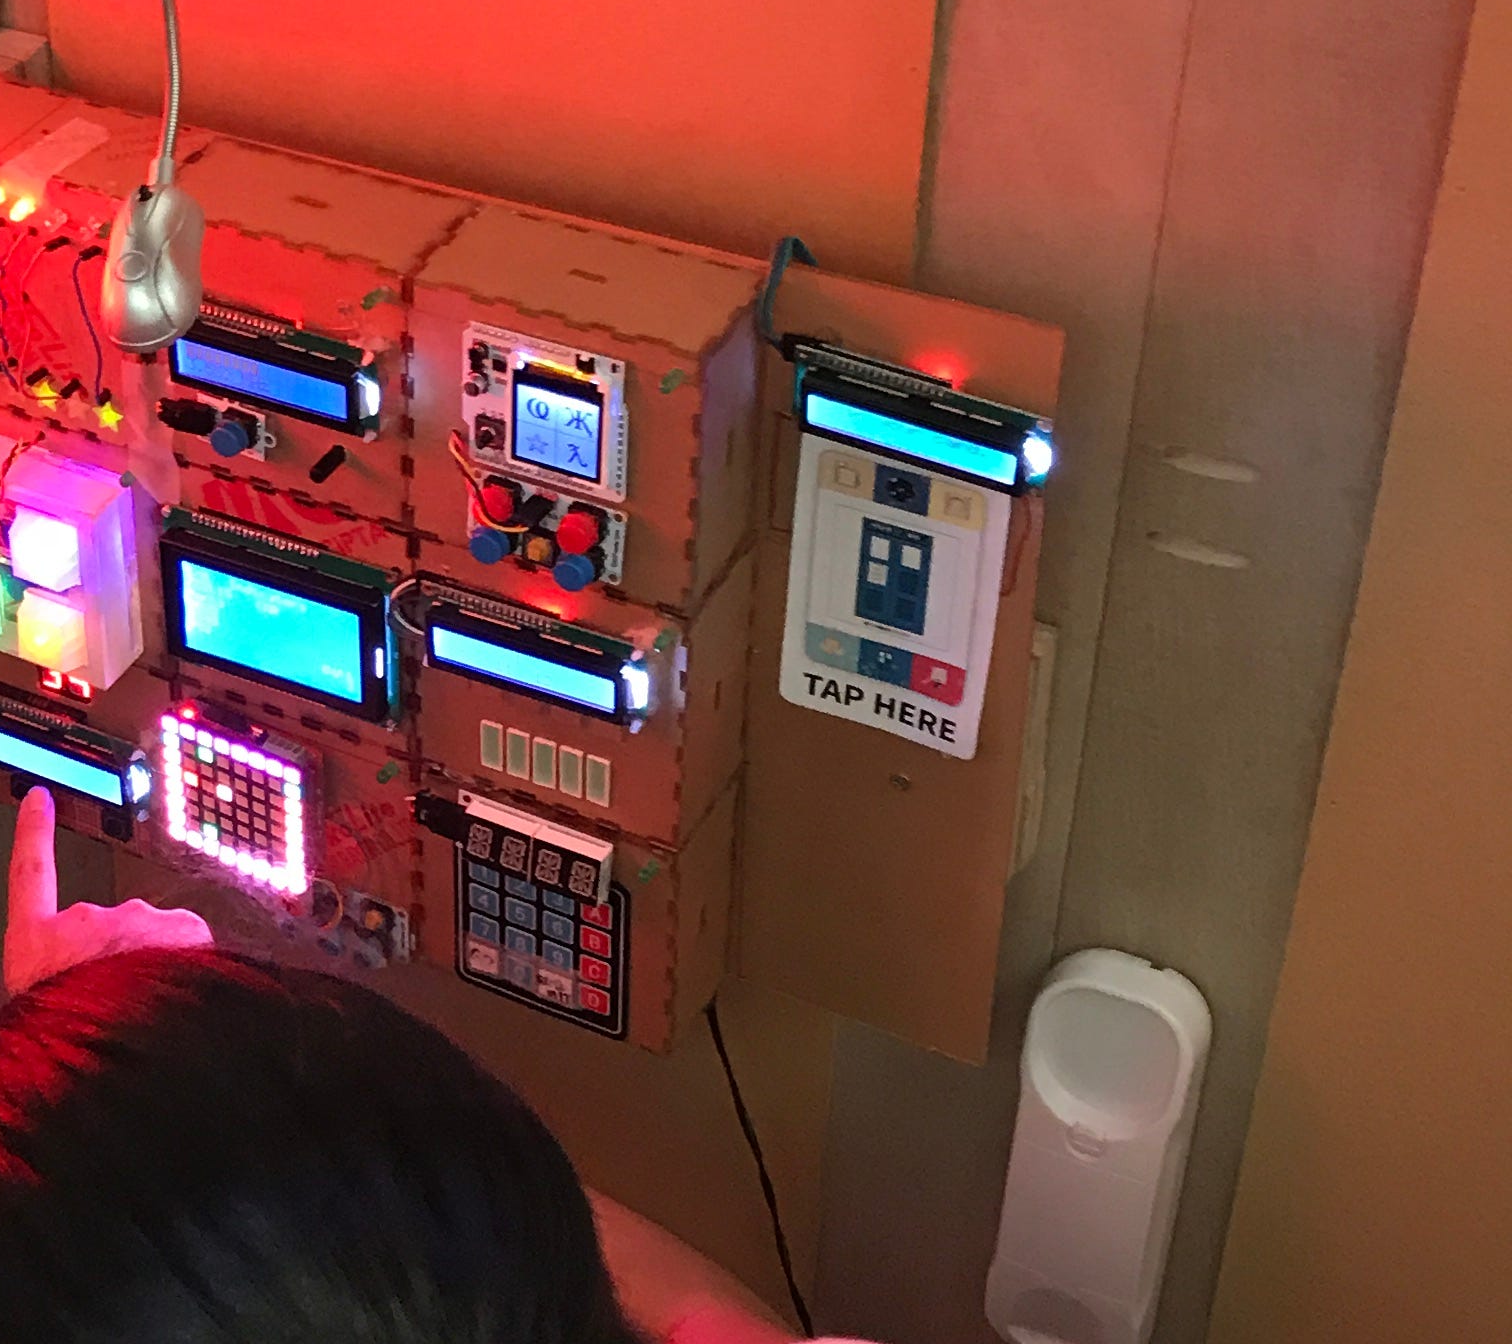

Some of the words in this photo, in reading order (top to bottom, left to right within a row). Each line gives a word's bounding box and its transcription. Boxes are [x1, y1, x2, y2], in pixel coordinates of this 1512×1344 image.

[803, 672, 865, 706] TAP
[874, 693, 957, 744] HERE
[588, 934, 601, 950] B
[588, 964, 601, 980] C
